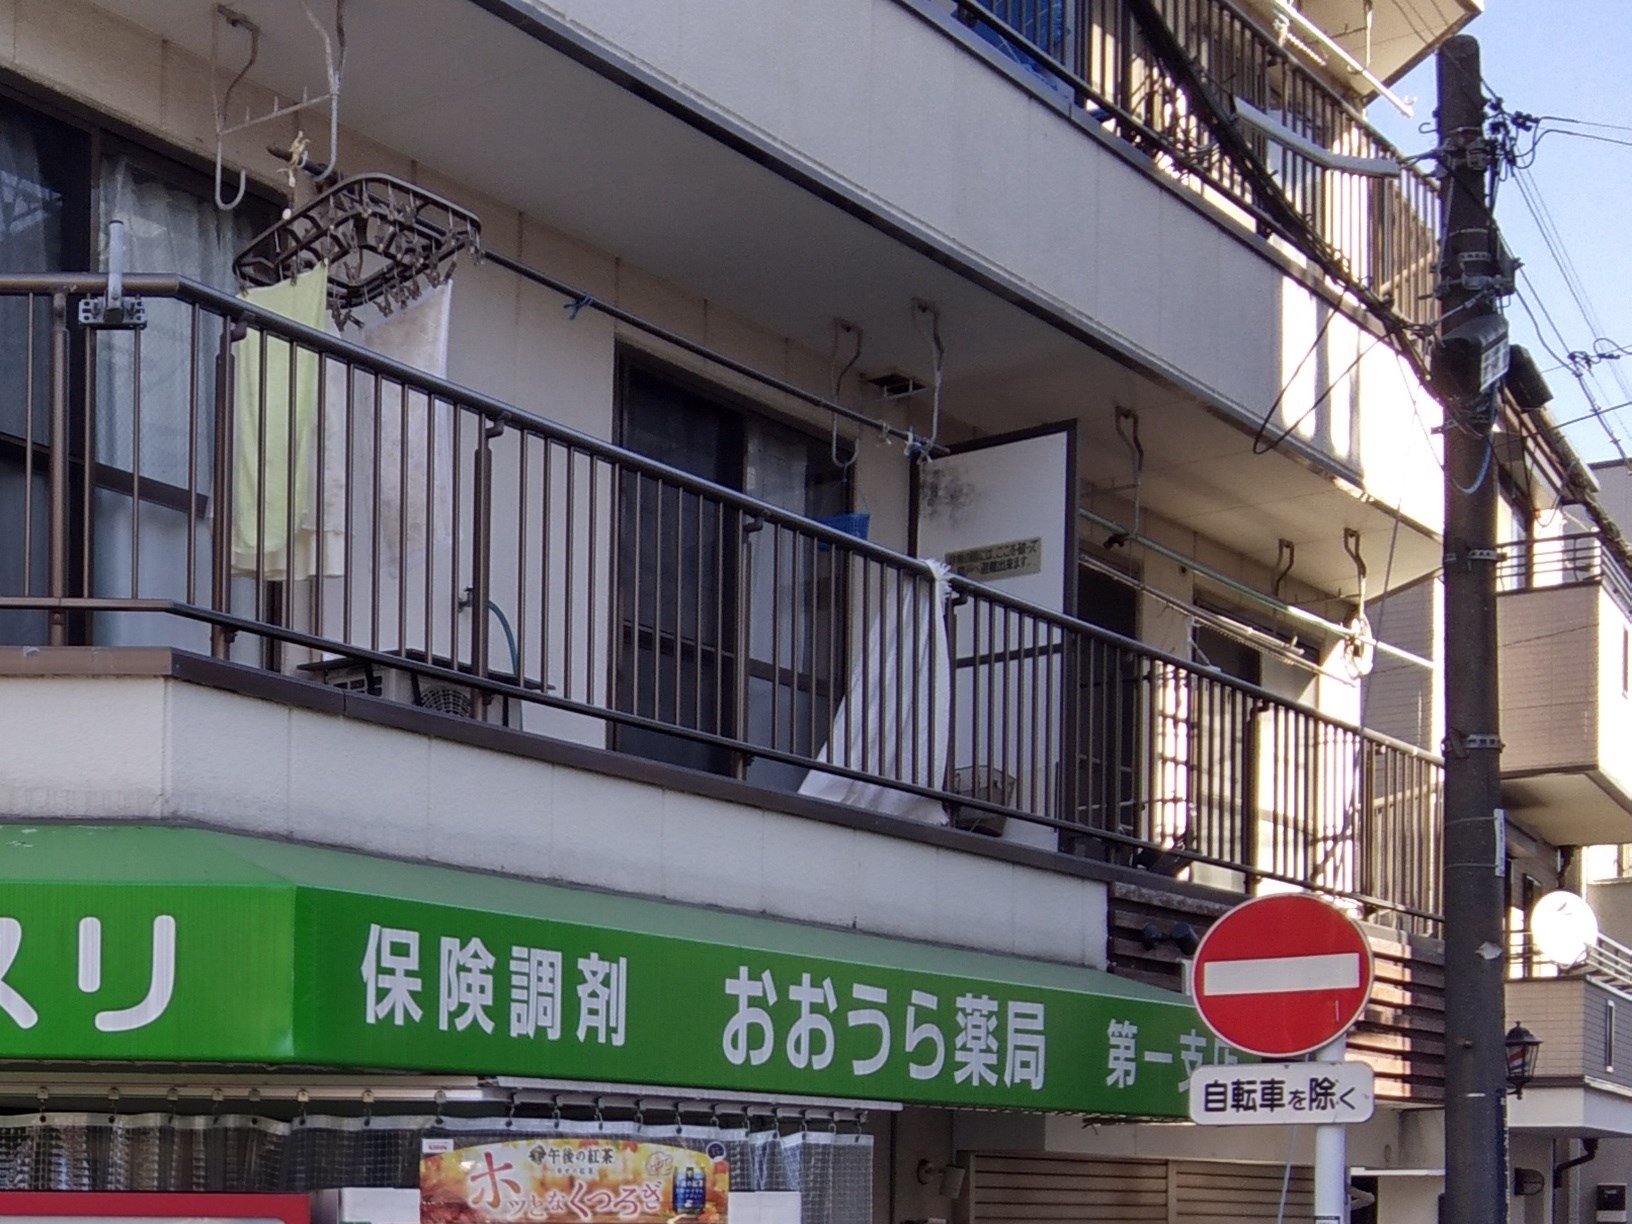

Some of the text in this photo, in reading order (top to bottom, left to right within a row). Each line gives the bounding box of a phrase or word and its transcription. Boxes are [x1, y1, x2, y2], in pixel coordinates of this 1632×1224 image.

[362, 923, 628, 1048] 保険調剤
[723, 967, 1046, 1091] おおうら薬局
[1204, 1077, 1356, 1113] 自転車を除く
[548, 1147, 615, 1165] 午後の紅茶
